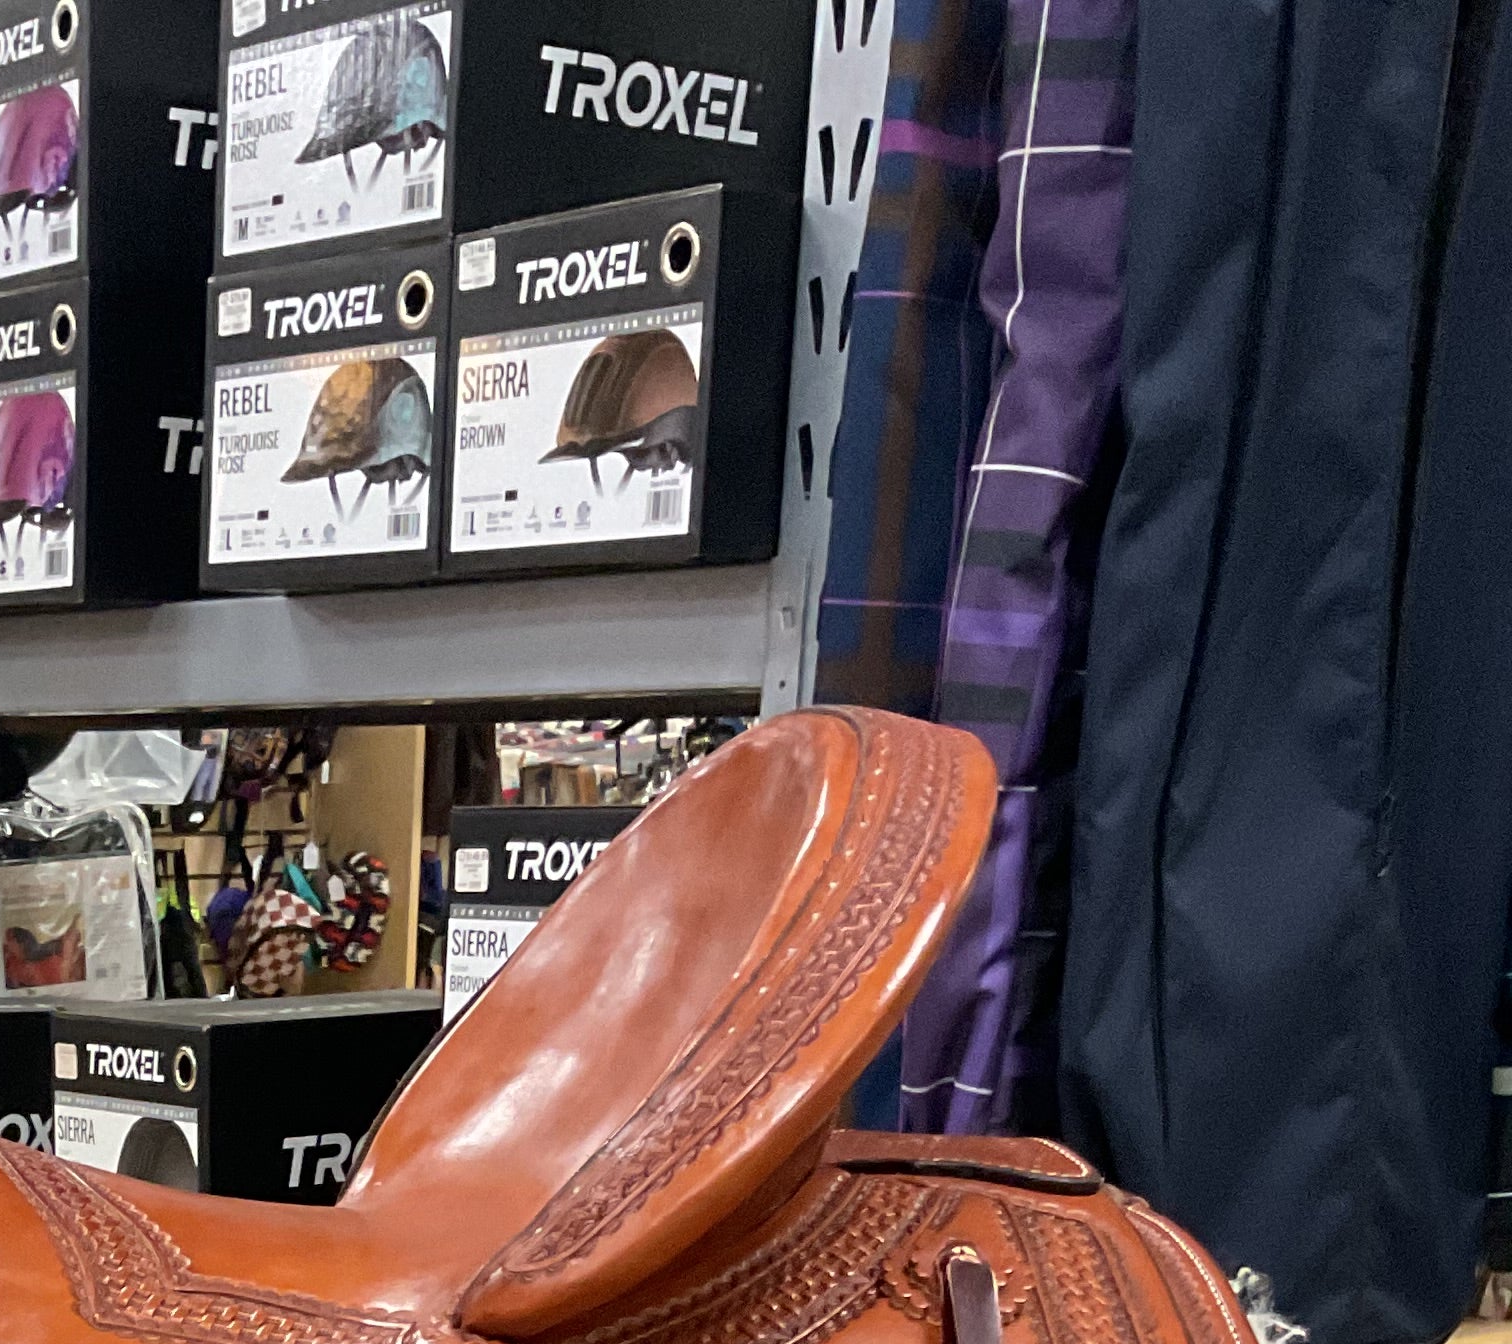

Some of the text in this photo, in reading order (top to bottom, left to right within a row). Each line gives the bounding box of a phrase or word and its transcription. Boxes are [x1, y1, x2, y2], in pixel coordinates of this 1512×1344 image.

[232, 62, 287, 104] REBEL
[541, 44, 759, 146] TROXEL
[231, 141, 259, 164] ROSE
[516, 240, 647, 304] TROXEL
[264, 284, 384, 339] TROXEL
[462, 359, 530, 405] SIERRA
[219, 383, 273, 418] REBEL
[218, 429, 280, 456] TURQUOISE
[460, 422, 506, 450] BROWN
[217, 455, 246, 475] ROSE
[452, 928, 509, 958] SIERRA
[86, 1043, 166, 1083] TROXEL
[57, 1115, 96, 1146] SIERRA
